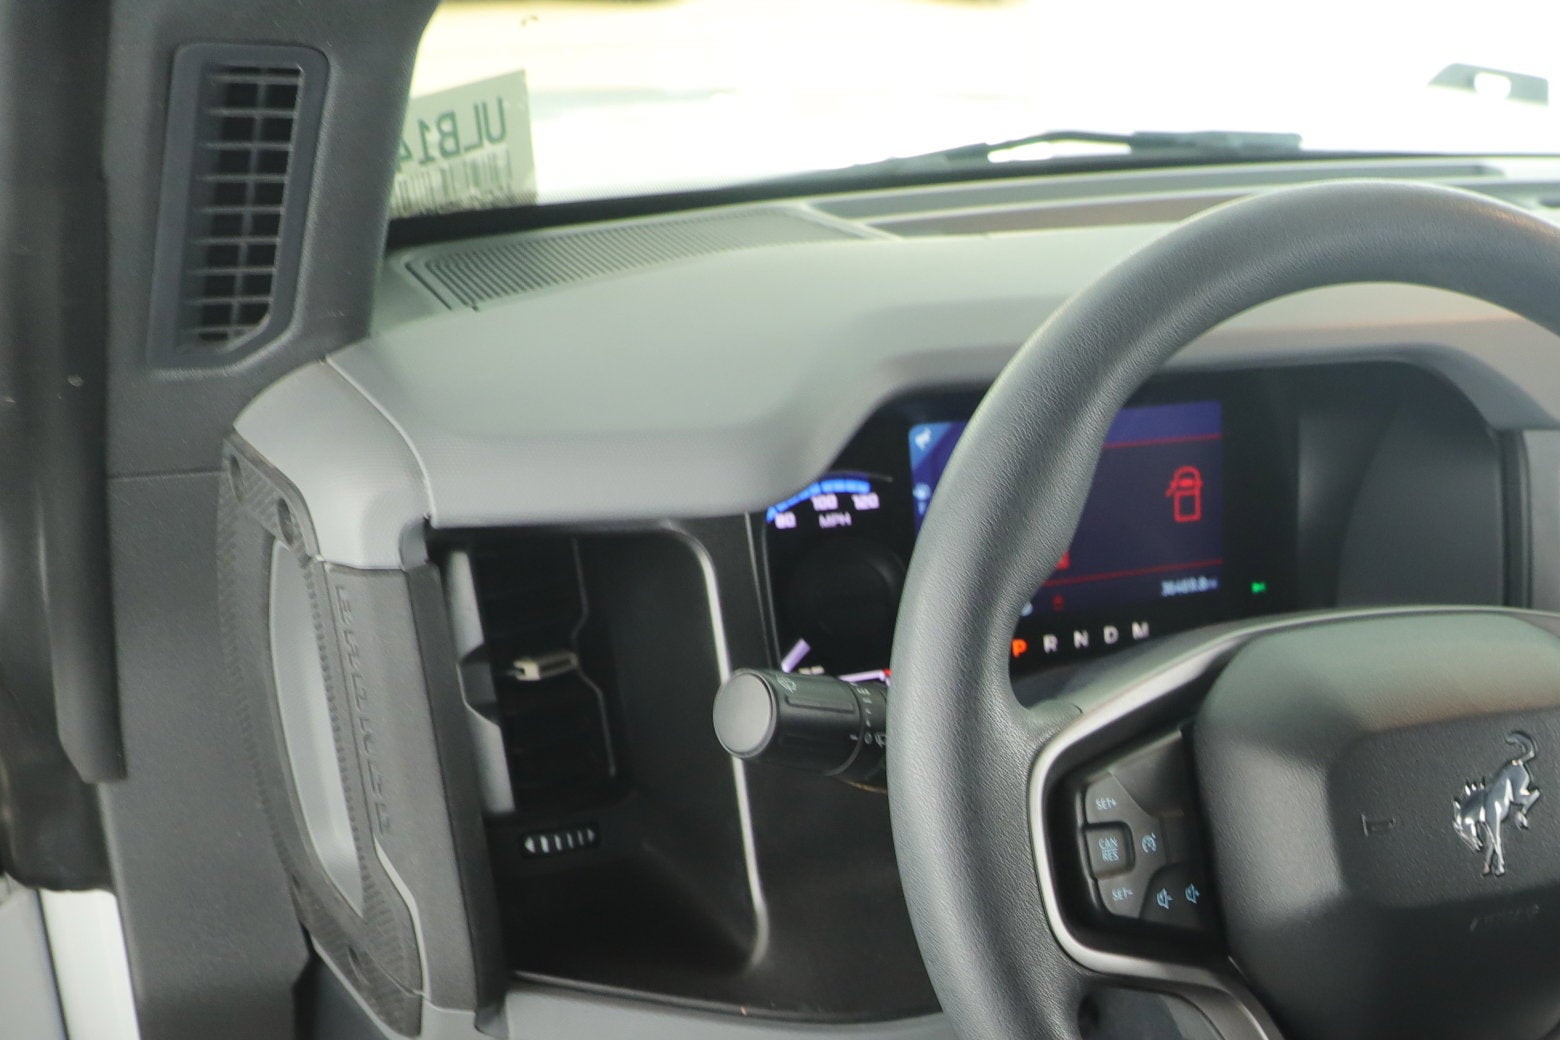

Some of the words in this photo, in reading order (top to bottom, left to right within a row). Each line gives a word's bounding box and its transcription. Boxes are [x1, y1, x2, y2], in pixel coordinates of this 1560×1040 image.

[810, 493, 838, 511] 100
[851, 492, 880, 511] 120
[819, 511, 852, 528] MPH
[1010, 638, 1028, 658] P
[1043, 633, 1059, 654] R
[1073, 630, 1089, 649] N
[1103, 625, 1120, 645] D
[1131, 621, 1150, 641] M
